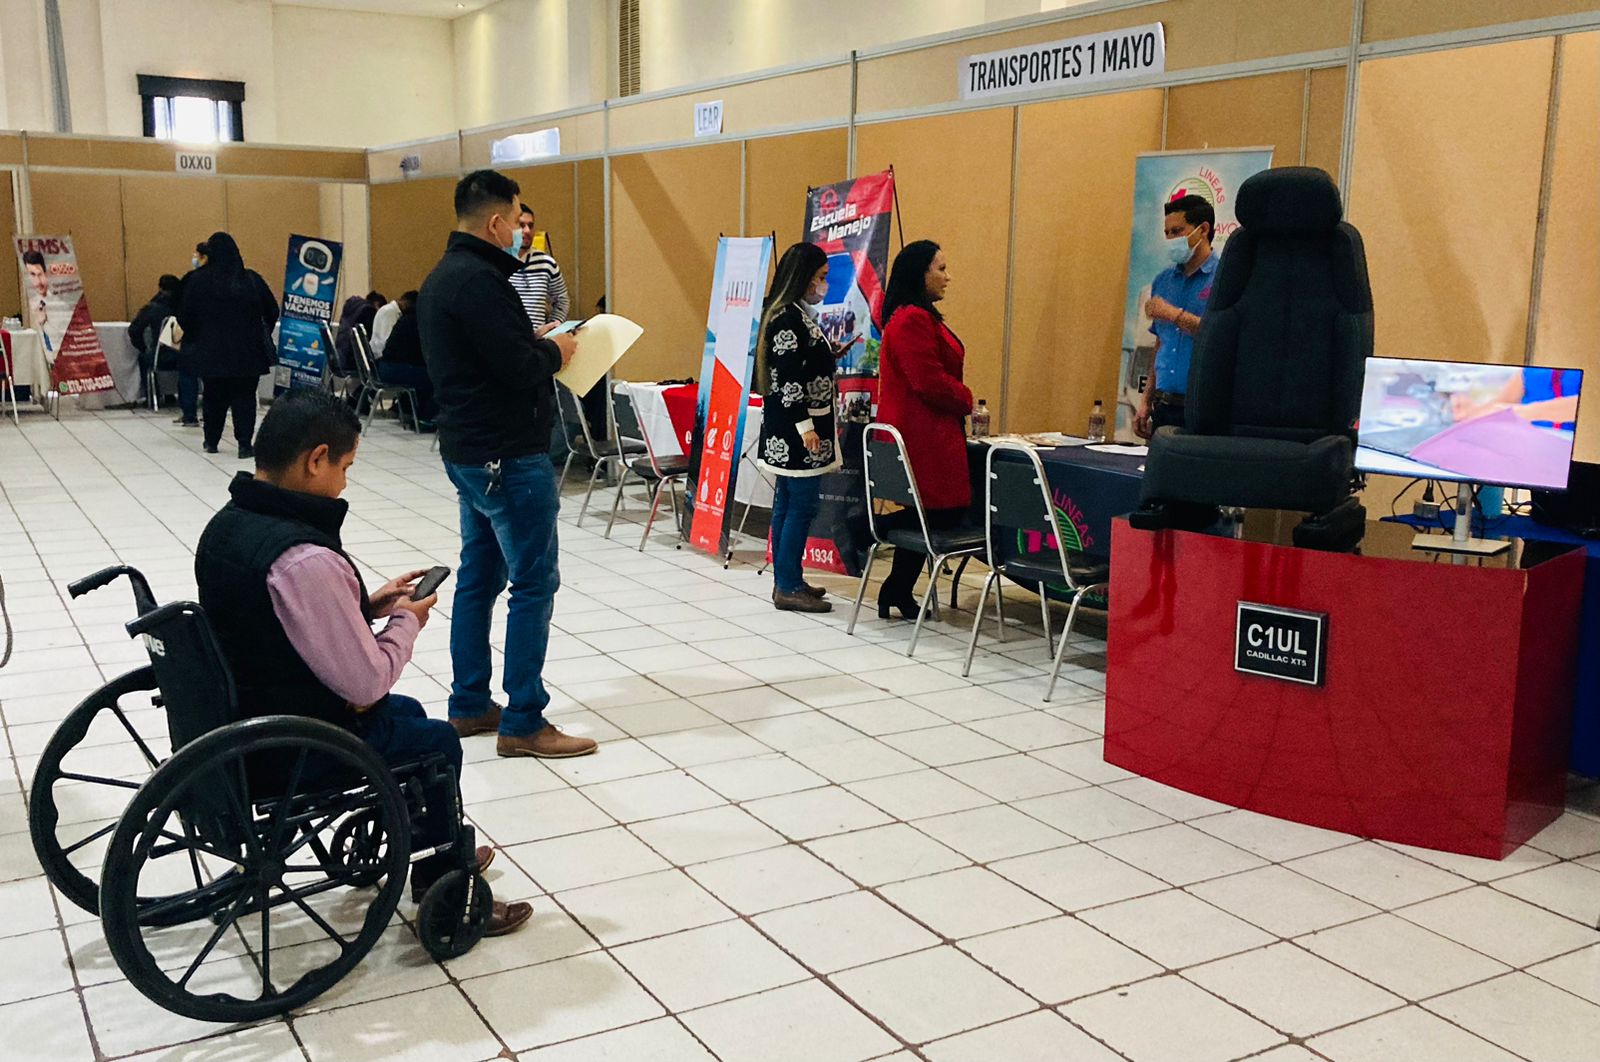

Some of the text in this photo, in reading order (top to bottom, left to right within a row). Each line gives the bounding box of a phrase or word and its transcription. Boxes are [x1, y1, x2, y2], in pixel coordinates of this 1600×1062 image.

[970, 32, 1155, 92] TRANSPORTES 1 MAYO
[697, 105, 719, 131] LEAR
[180, 154, 212, 170] OXXO
[1199, 166, 1225, 204] LINEAS
[810, 203, 857, 232] Escuela
[827, 214, 871, 242] Manejo
[284, 302, 331, 319] VACANTES
[288, 294, 331, 310] TENEMOS
[1053, 487, 1095, 548] LINEAS
[809, 547, 834, 564] 1934
[1247, 623, 1308, 656] C1UL
[1246, 649, 1289, 664] CADILLAC
